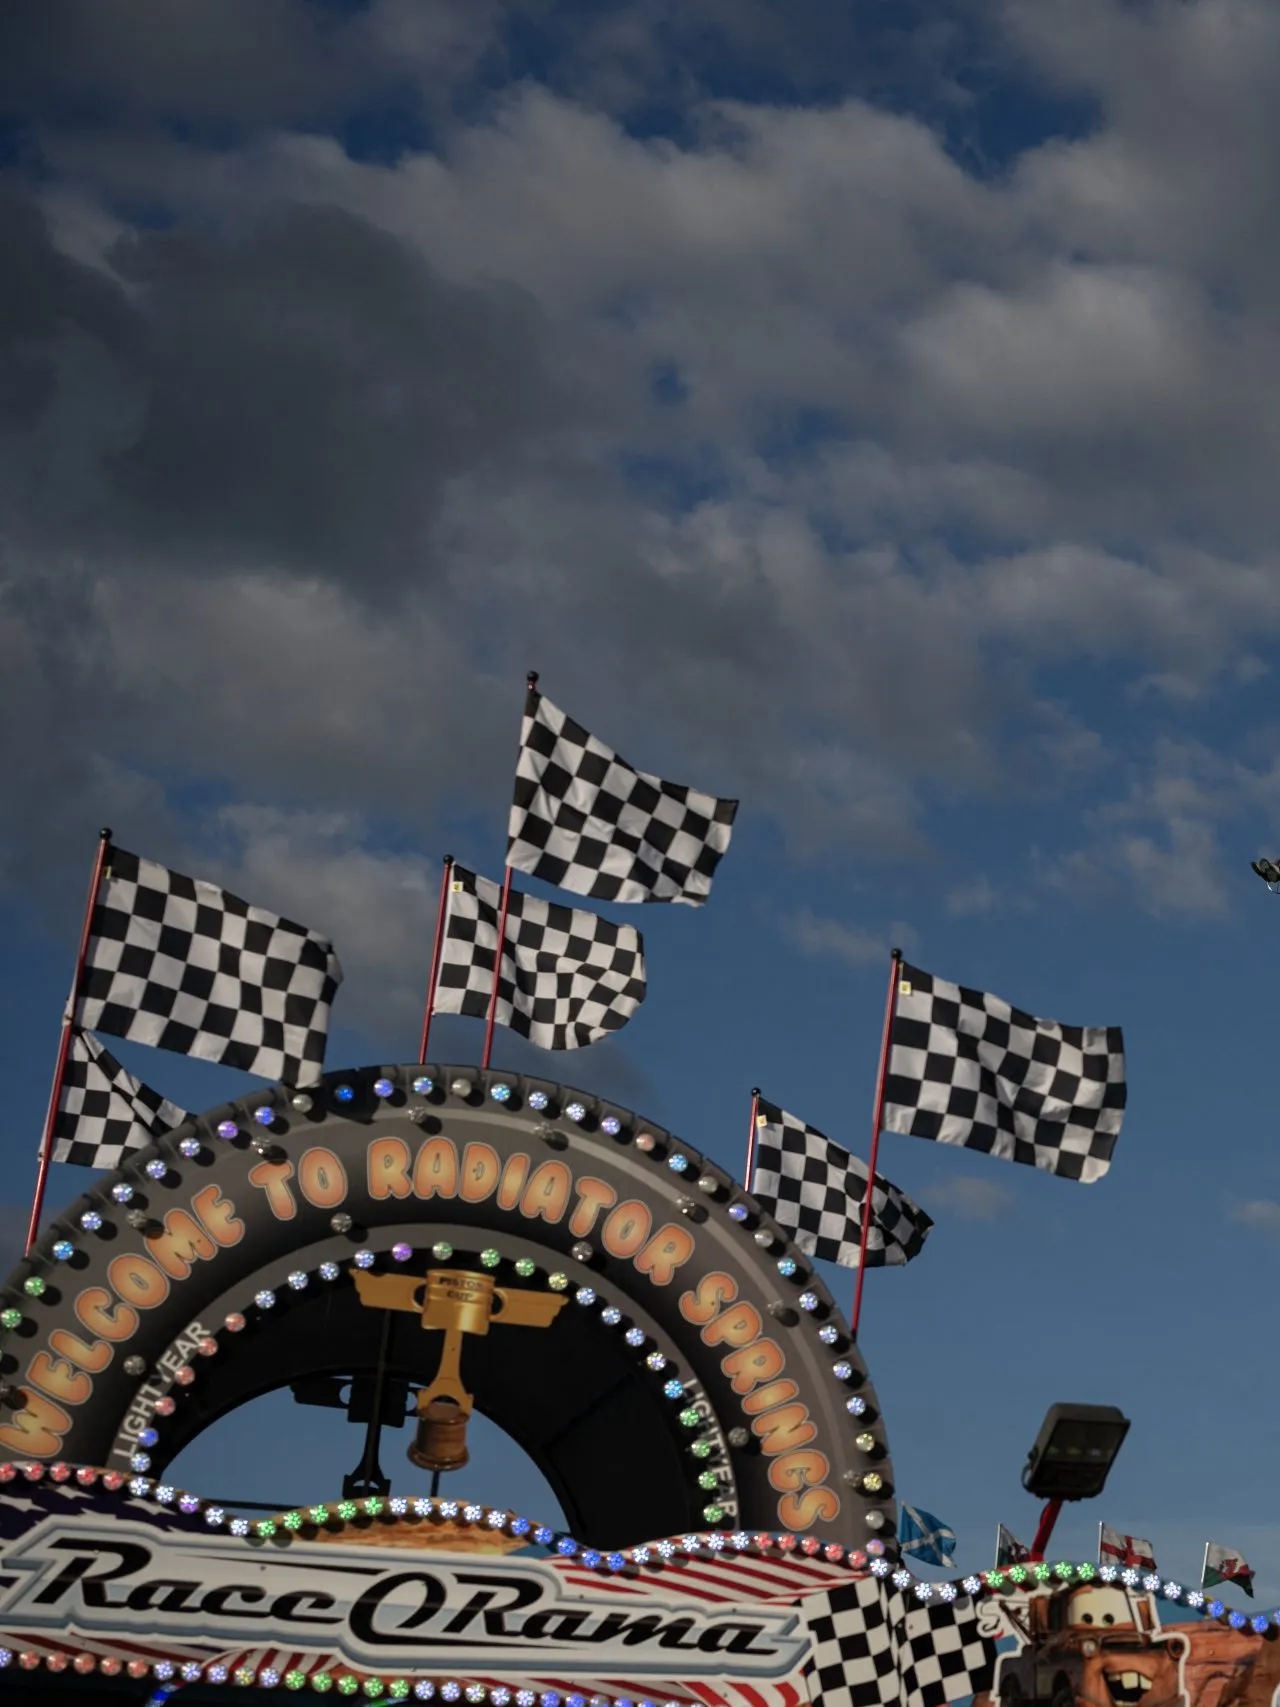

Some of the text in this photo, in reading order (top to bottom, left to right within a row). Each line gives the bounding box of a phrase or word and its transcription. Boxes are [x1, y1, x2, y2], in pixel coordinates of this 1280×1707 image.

[0, 1136, 840, 1532] WELCOME TO RADIATOR SPRINGS
